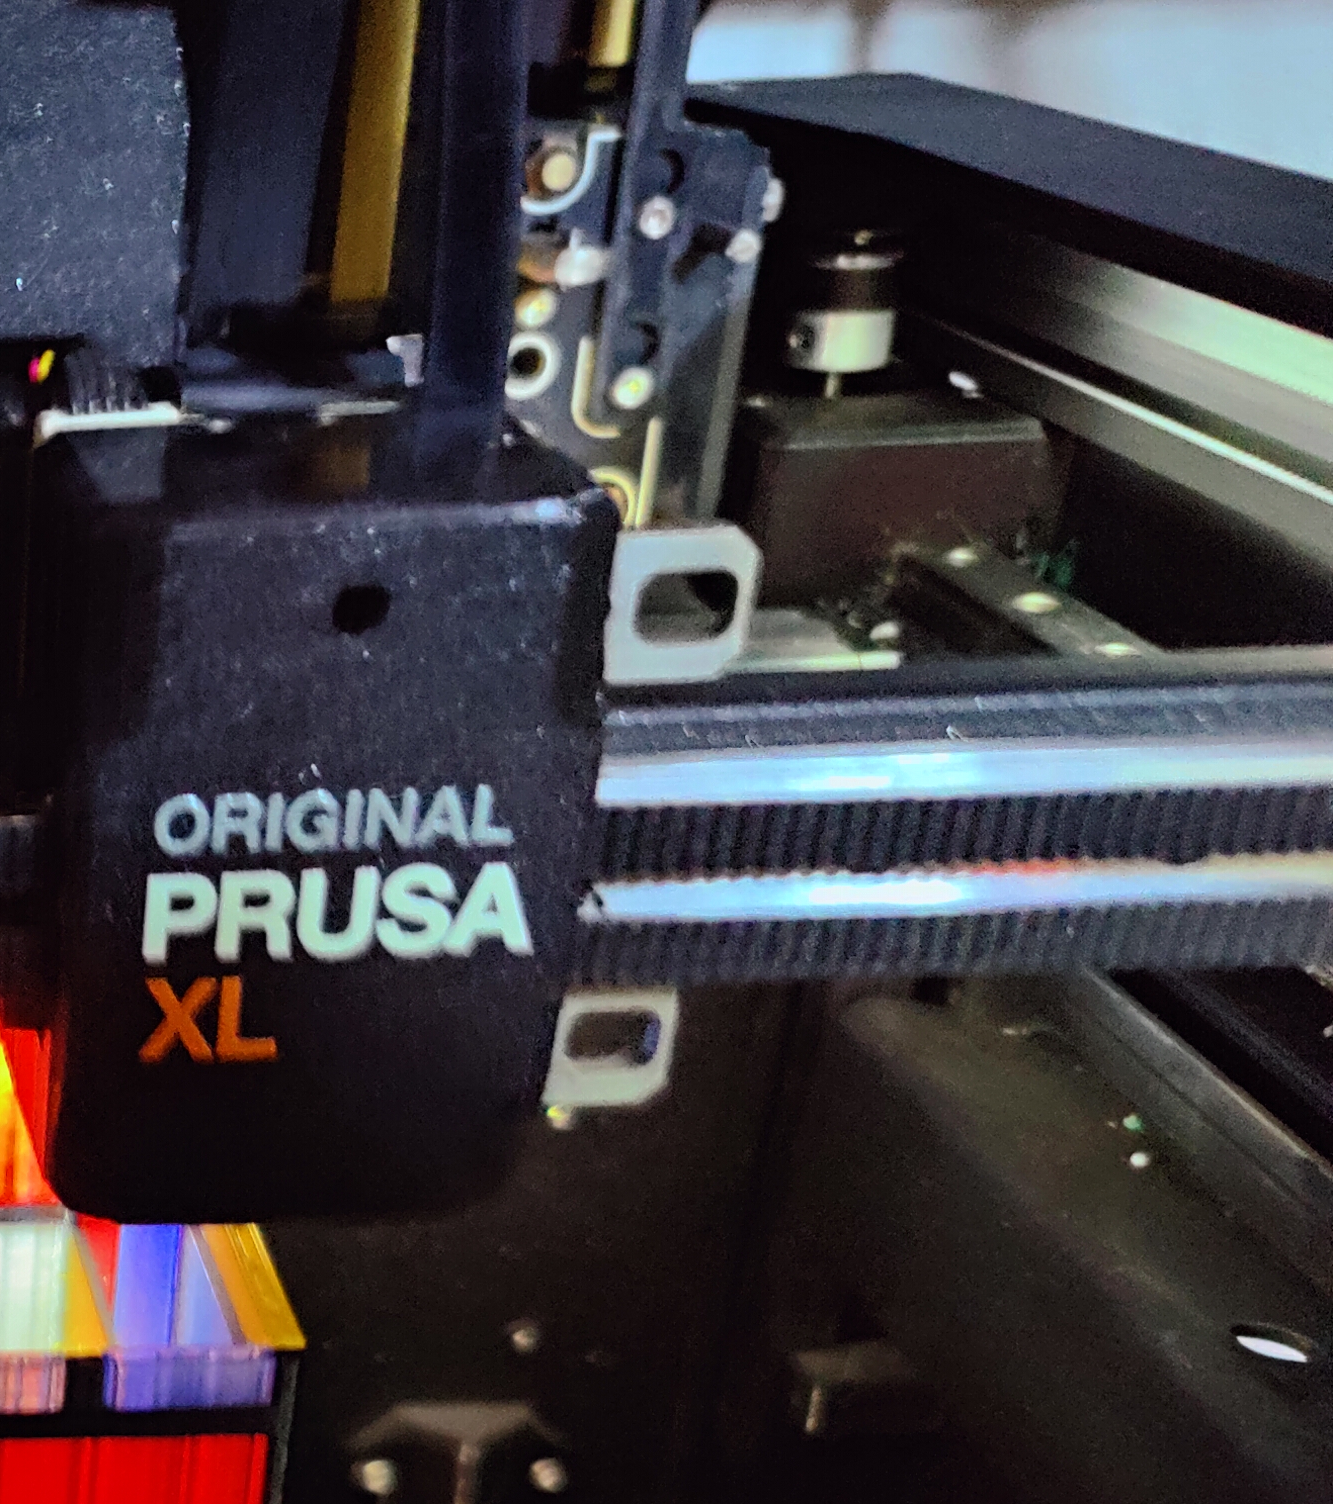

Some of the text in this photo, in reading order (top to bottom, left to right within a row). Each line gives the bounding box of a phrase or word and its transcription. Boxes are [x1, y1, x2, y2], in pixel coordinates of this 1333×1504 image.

[153, 783, 515, 857] ORIGINAL
[141, 860, 534, 964] PRUSA
[138, 973, 279, 1065] XL
